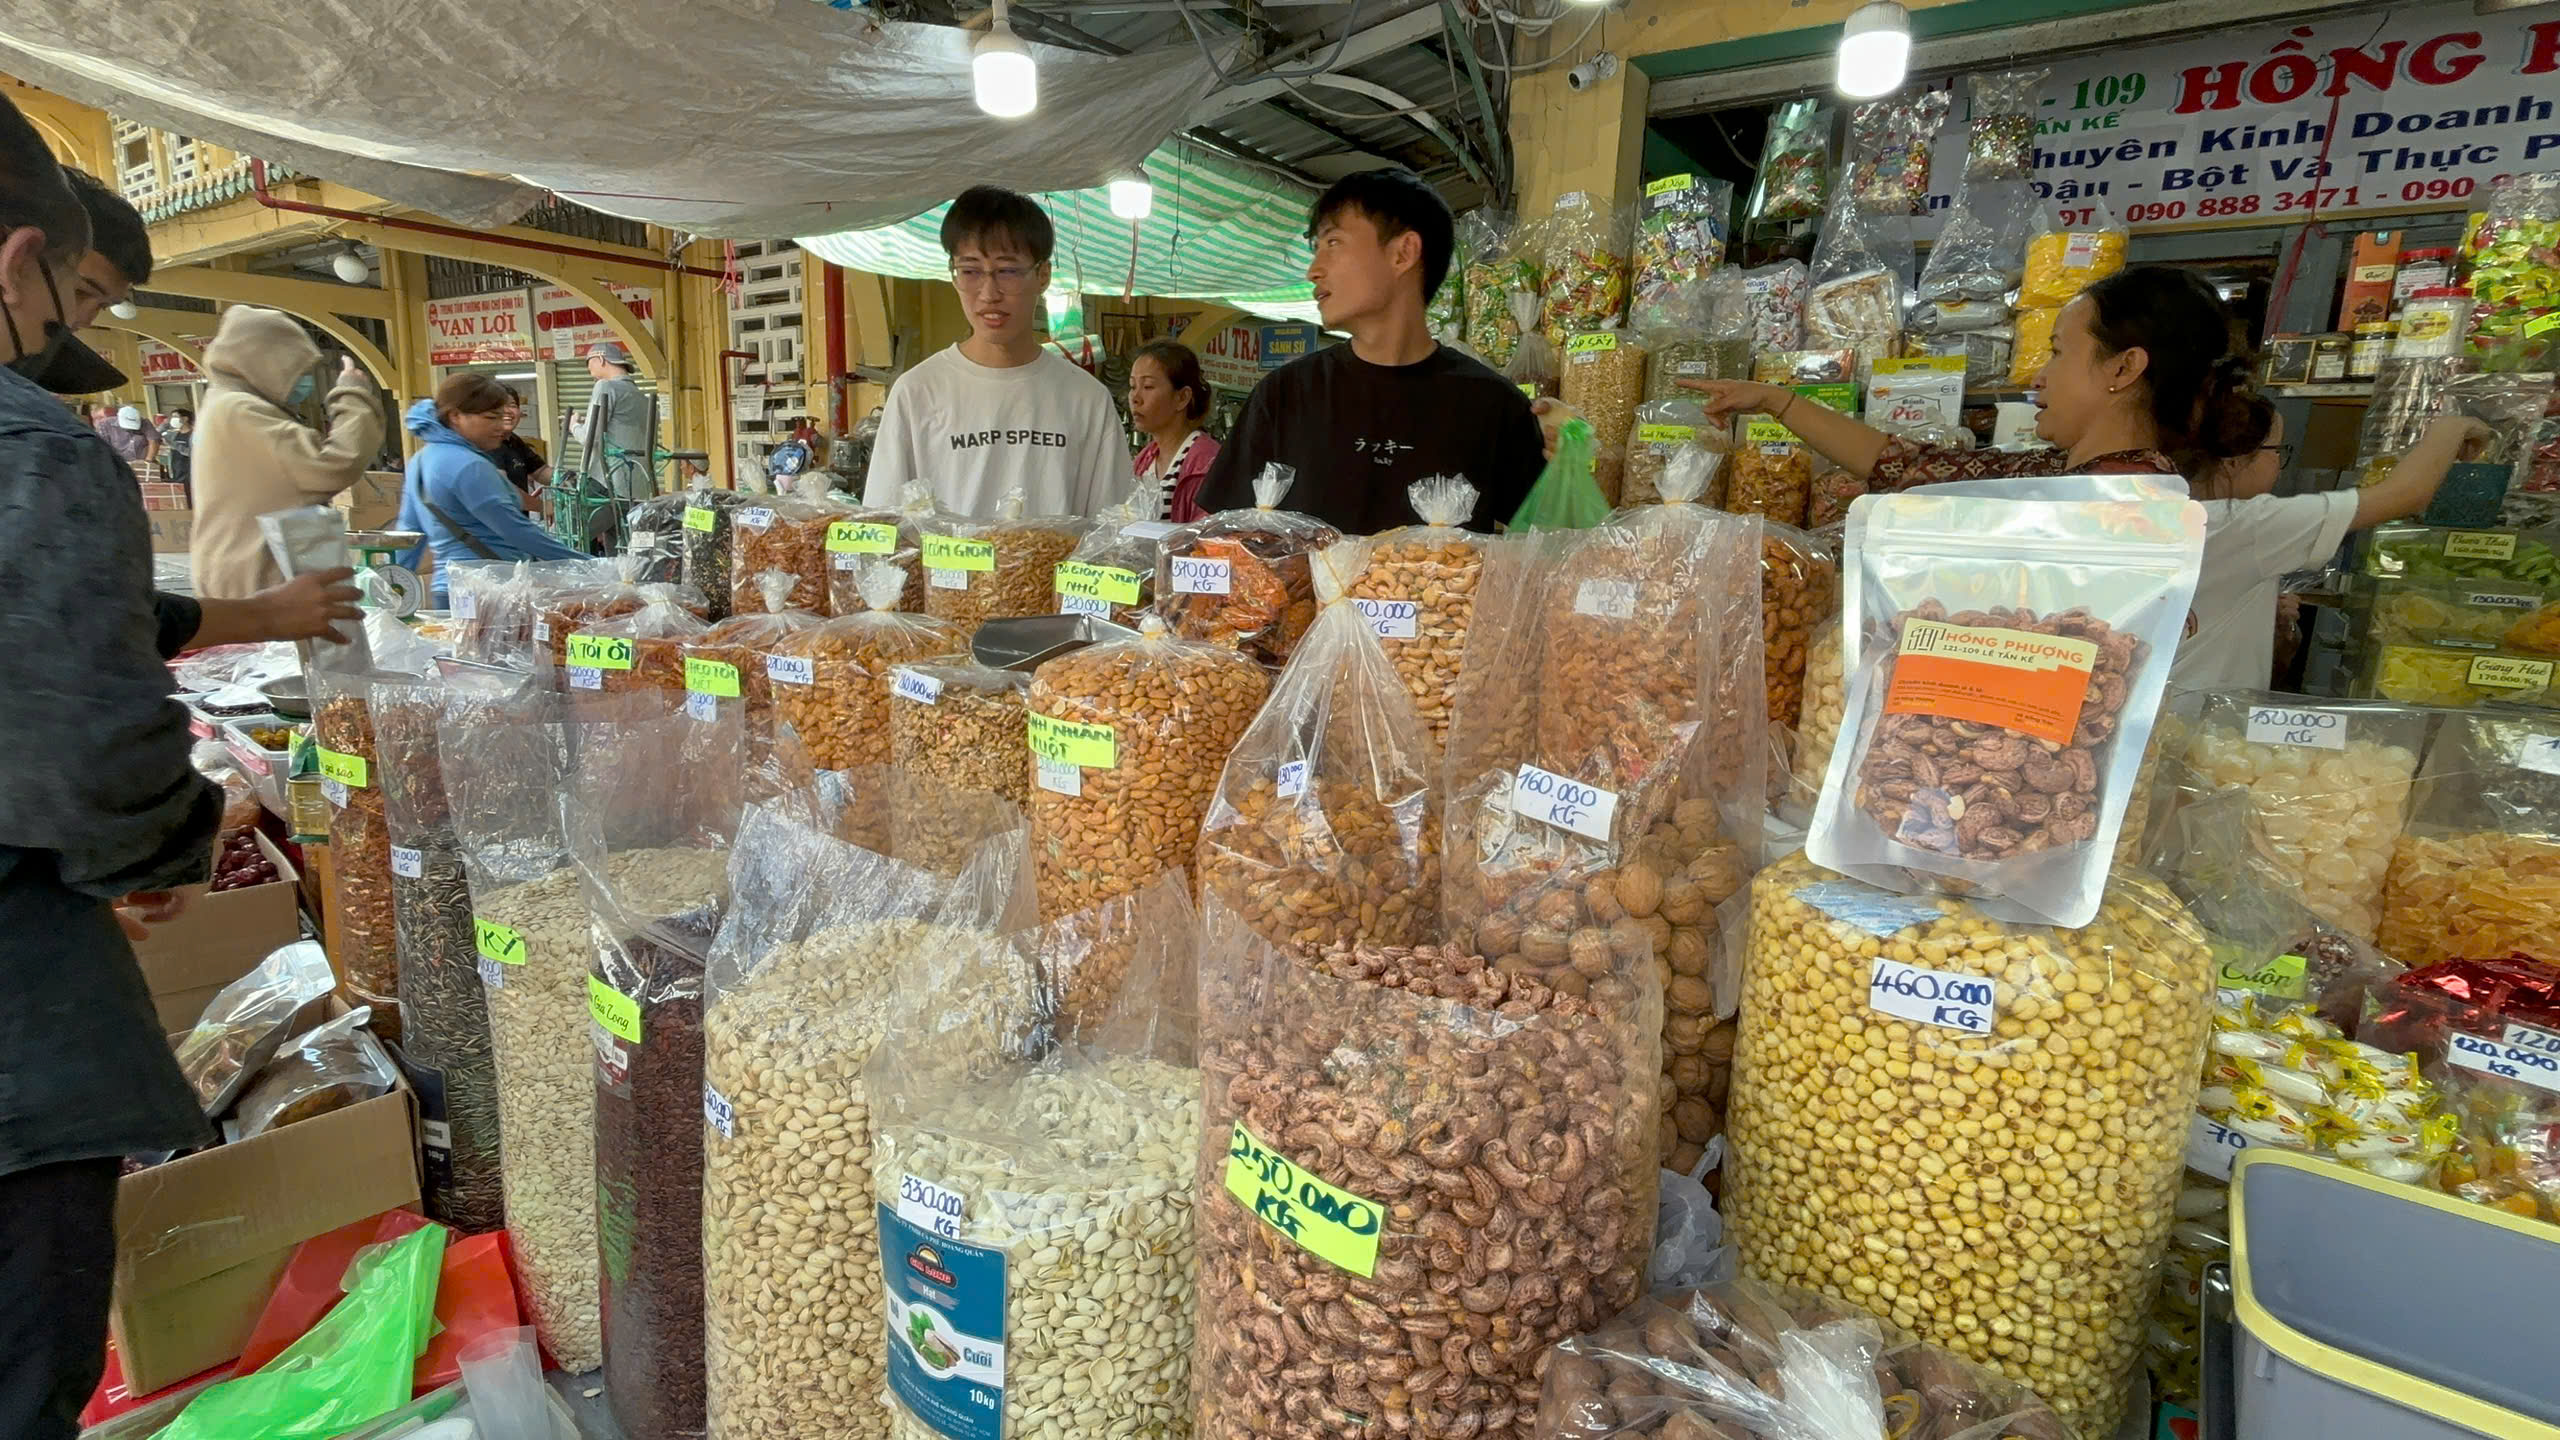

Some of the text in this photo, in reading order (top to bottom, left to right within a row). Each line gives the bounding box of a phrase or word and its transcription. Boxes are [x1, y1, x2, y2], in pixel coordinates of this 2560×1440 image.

[2174, 26, 2486, 114] HỒNG
[2070, 72, 2147, 112] 109
[2032, 96, 2553, 170] huyên Kinh Doanh
[2162, 164, 2249, 194] Bột
[2270, 155, 2333, 181] Và
[2358, 143, 2500, 174] Thực
[2126, 201, 2186, 223] 090
[2196, 194, 2260, 217] 888
[2272, 185, 2360, 213] 3471
[2402, 176, 2476, 202] 090
[438, 311, 518, 339] VẠN LỢI
[951, 429, 1067, 449] WARP SPEED
[1354, 437, 1415, 454] ラッキー
[1193, 579, 1216, 592] KG
[2004, 638, 2084, 664] PHƯỢNG
[2283, 729, 2318, 743] KG
[1518, 769, 1598, 807] 160.000
[1549, 803, 1590, 828] KG
[1871, 963, 1993, 1006] 460.000
[1932, 1005, 1988, 1030] KG
[900, 1174, 962, 1217] 330.000
[1231, 1128, 1379, 1236] 250.000
[934, 1216, 961, 1238] KG
[1254, 1187, 1309, 1241] KG
[969, 1388, 996, 1410] 10kg
